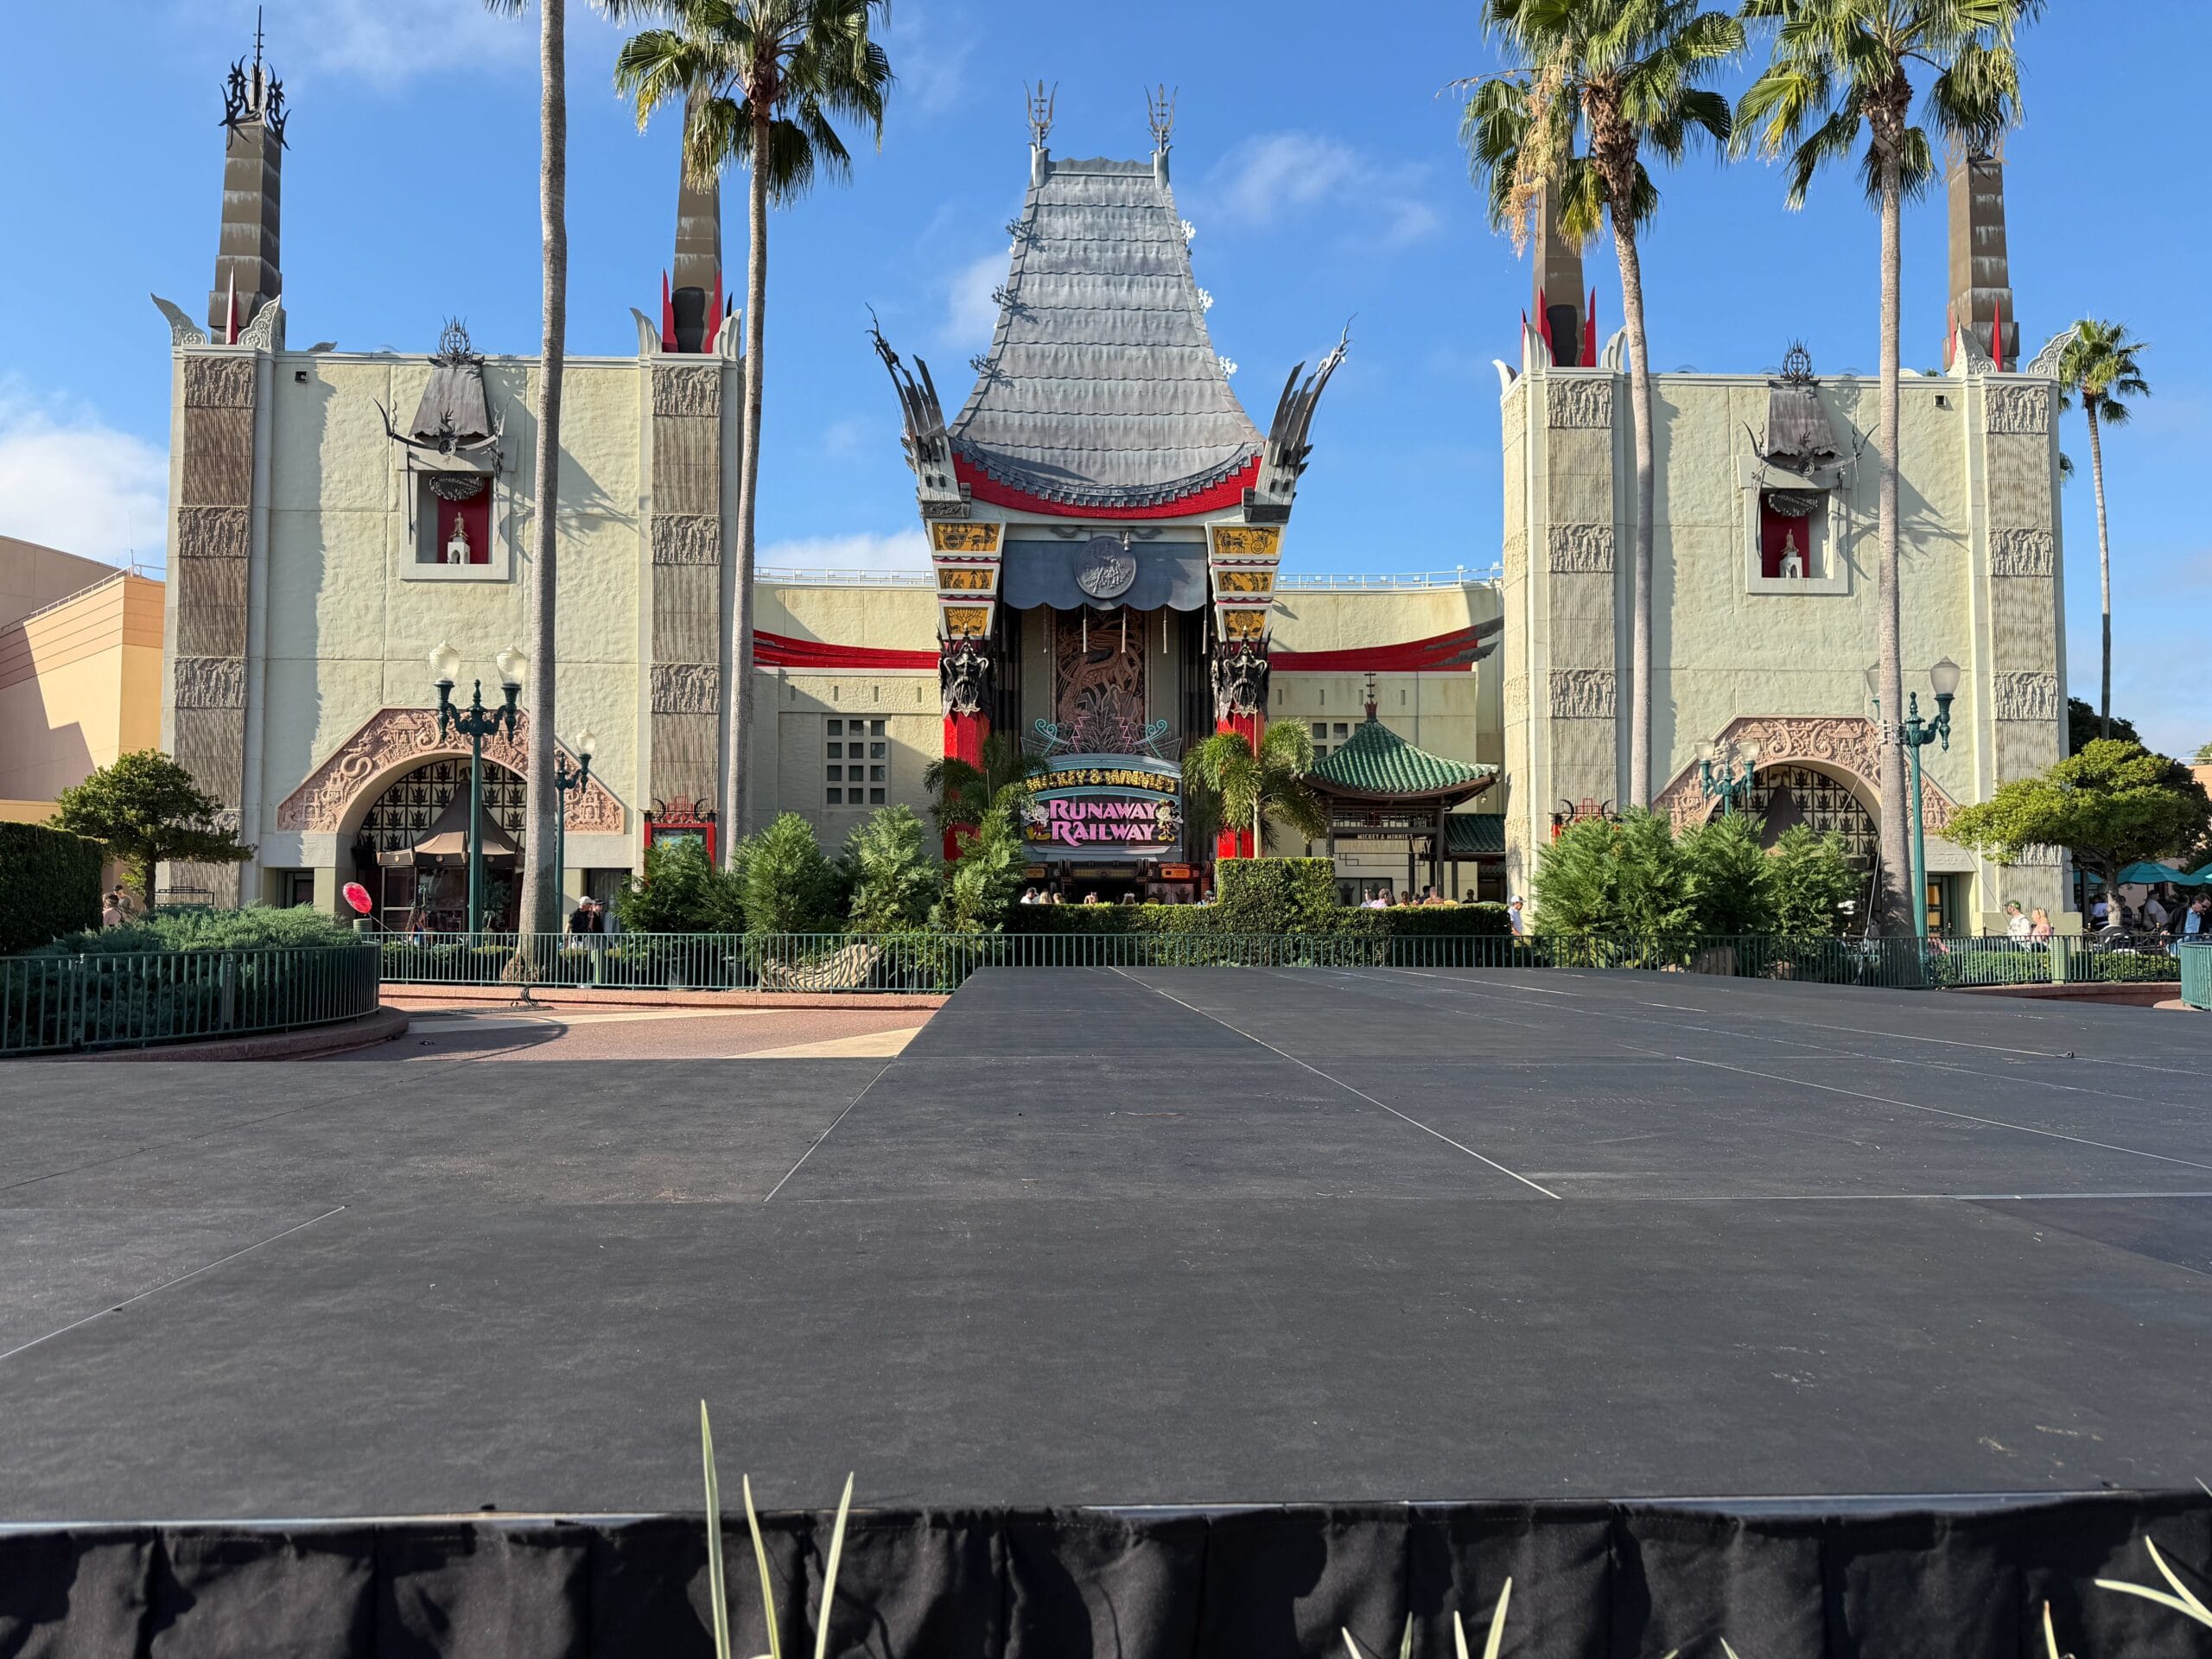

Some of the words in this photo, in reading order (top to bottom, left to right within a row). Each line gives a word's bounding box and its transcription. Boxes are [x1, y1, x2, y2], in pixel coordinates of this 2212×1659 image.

[1027, 769, 1087, 793] MICKEY
[1090, 768, 1101, 784] &
[1049, 799, 1159, 820] RUNAWAY
[1052, 821, 1156, 847] RAILWAY
